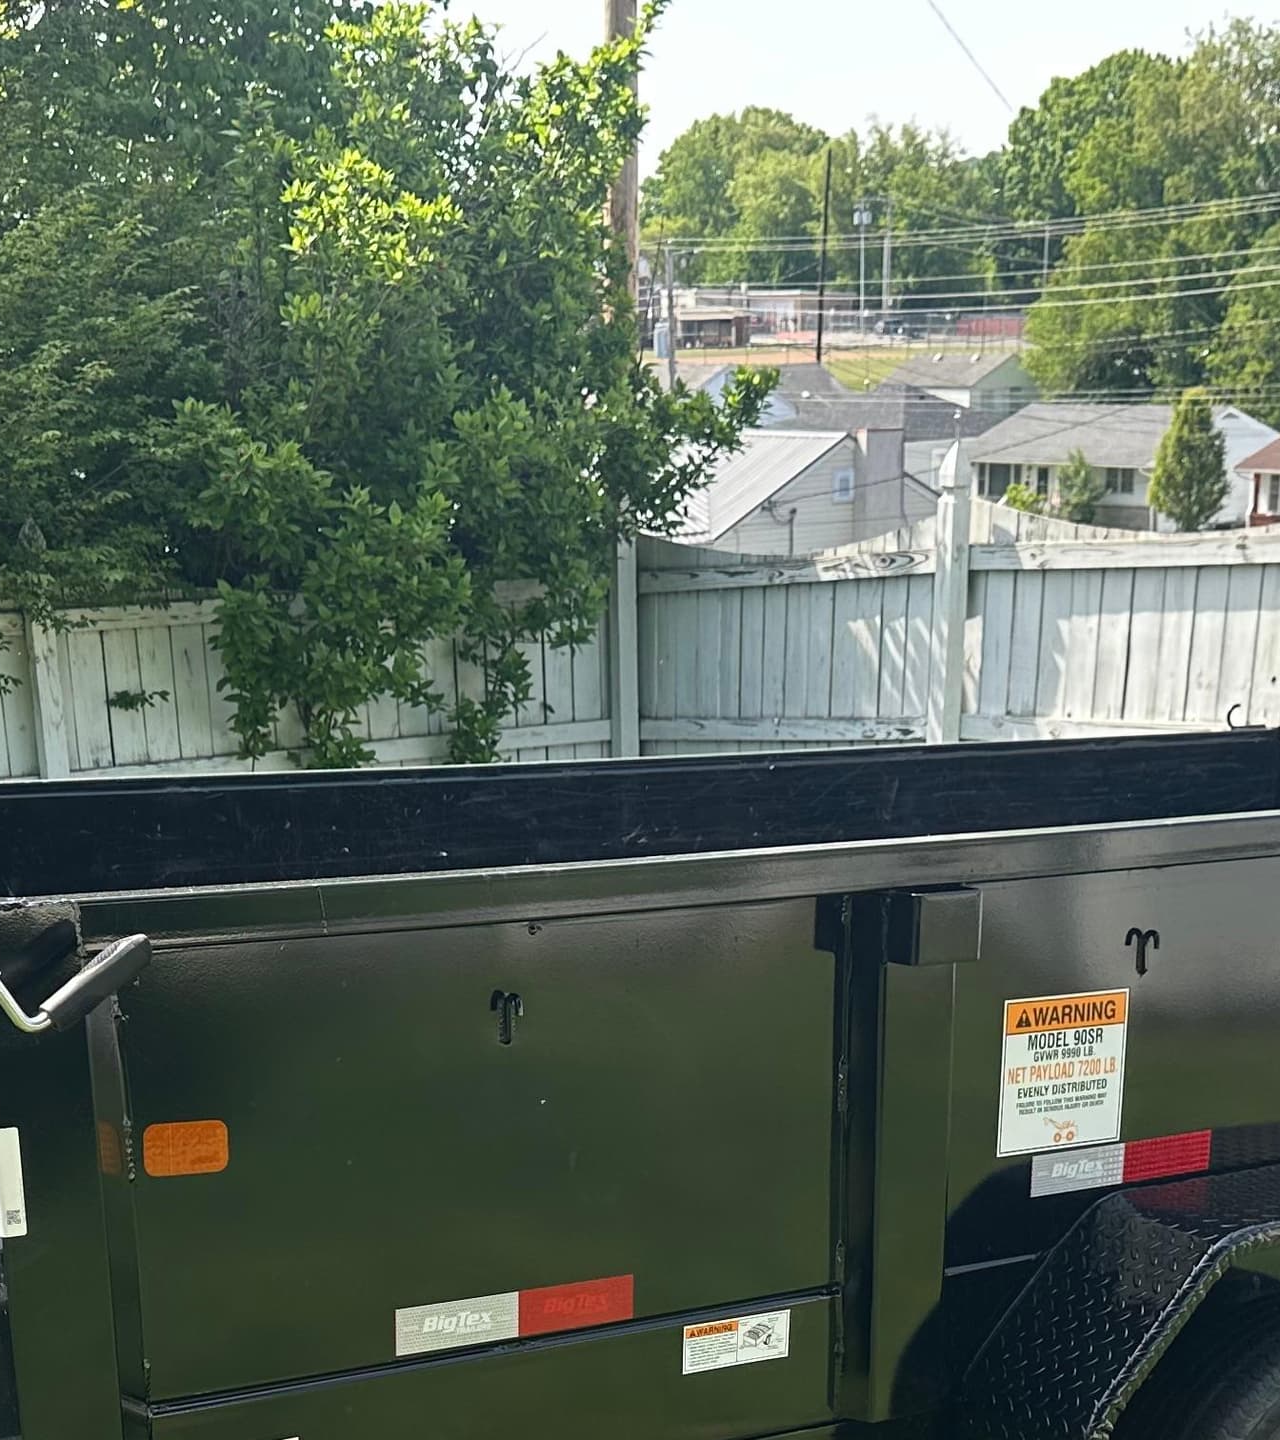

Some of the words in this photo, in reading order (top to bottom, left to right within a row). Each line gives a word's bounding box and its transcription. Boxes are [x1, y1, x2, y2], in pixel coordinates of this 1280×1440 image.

[1033, 1000, 1116, 1026] WARNING
[1028, 1032, 1069, 1050] MODEL
[1074, 1028, 1104, 1046] 90SR
[1034, 1050, 1058, 1062] GVWR
[1062, 1047, 1081, 1059] 9990
[1008, 1068, 1026, 1084] NET
[1030, 1062, 1074, 1082] PAYLOAD
[1078, 1059, 1100, 1077] 7200
[1018, 1085, 1049, 1099] EVENLY
[1052, 1078, 1107, 1094] DISTRIBUTED
[1051, 1159, 1105, 1178] BigTex
[423, 1310, 492, 1334] BigTex
[696, 1326, 732, 1337] WARNING
